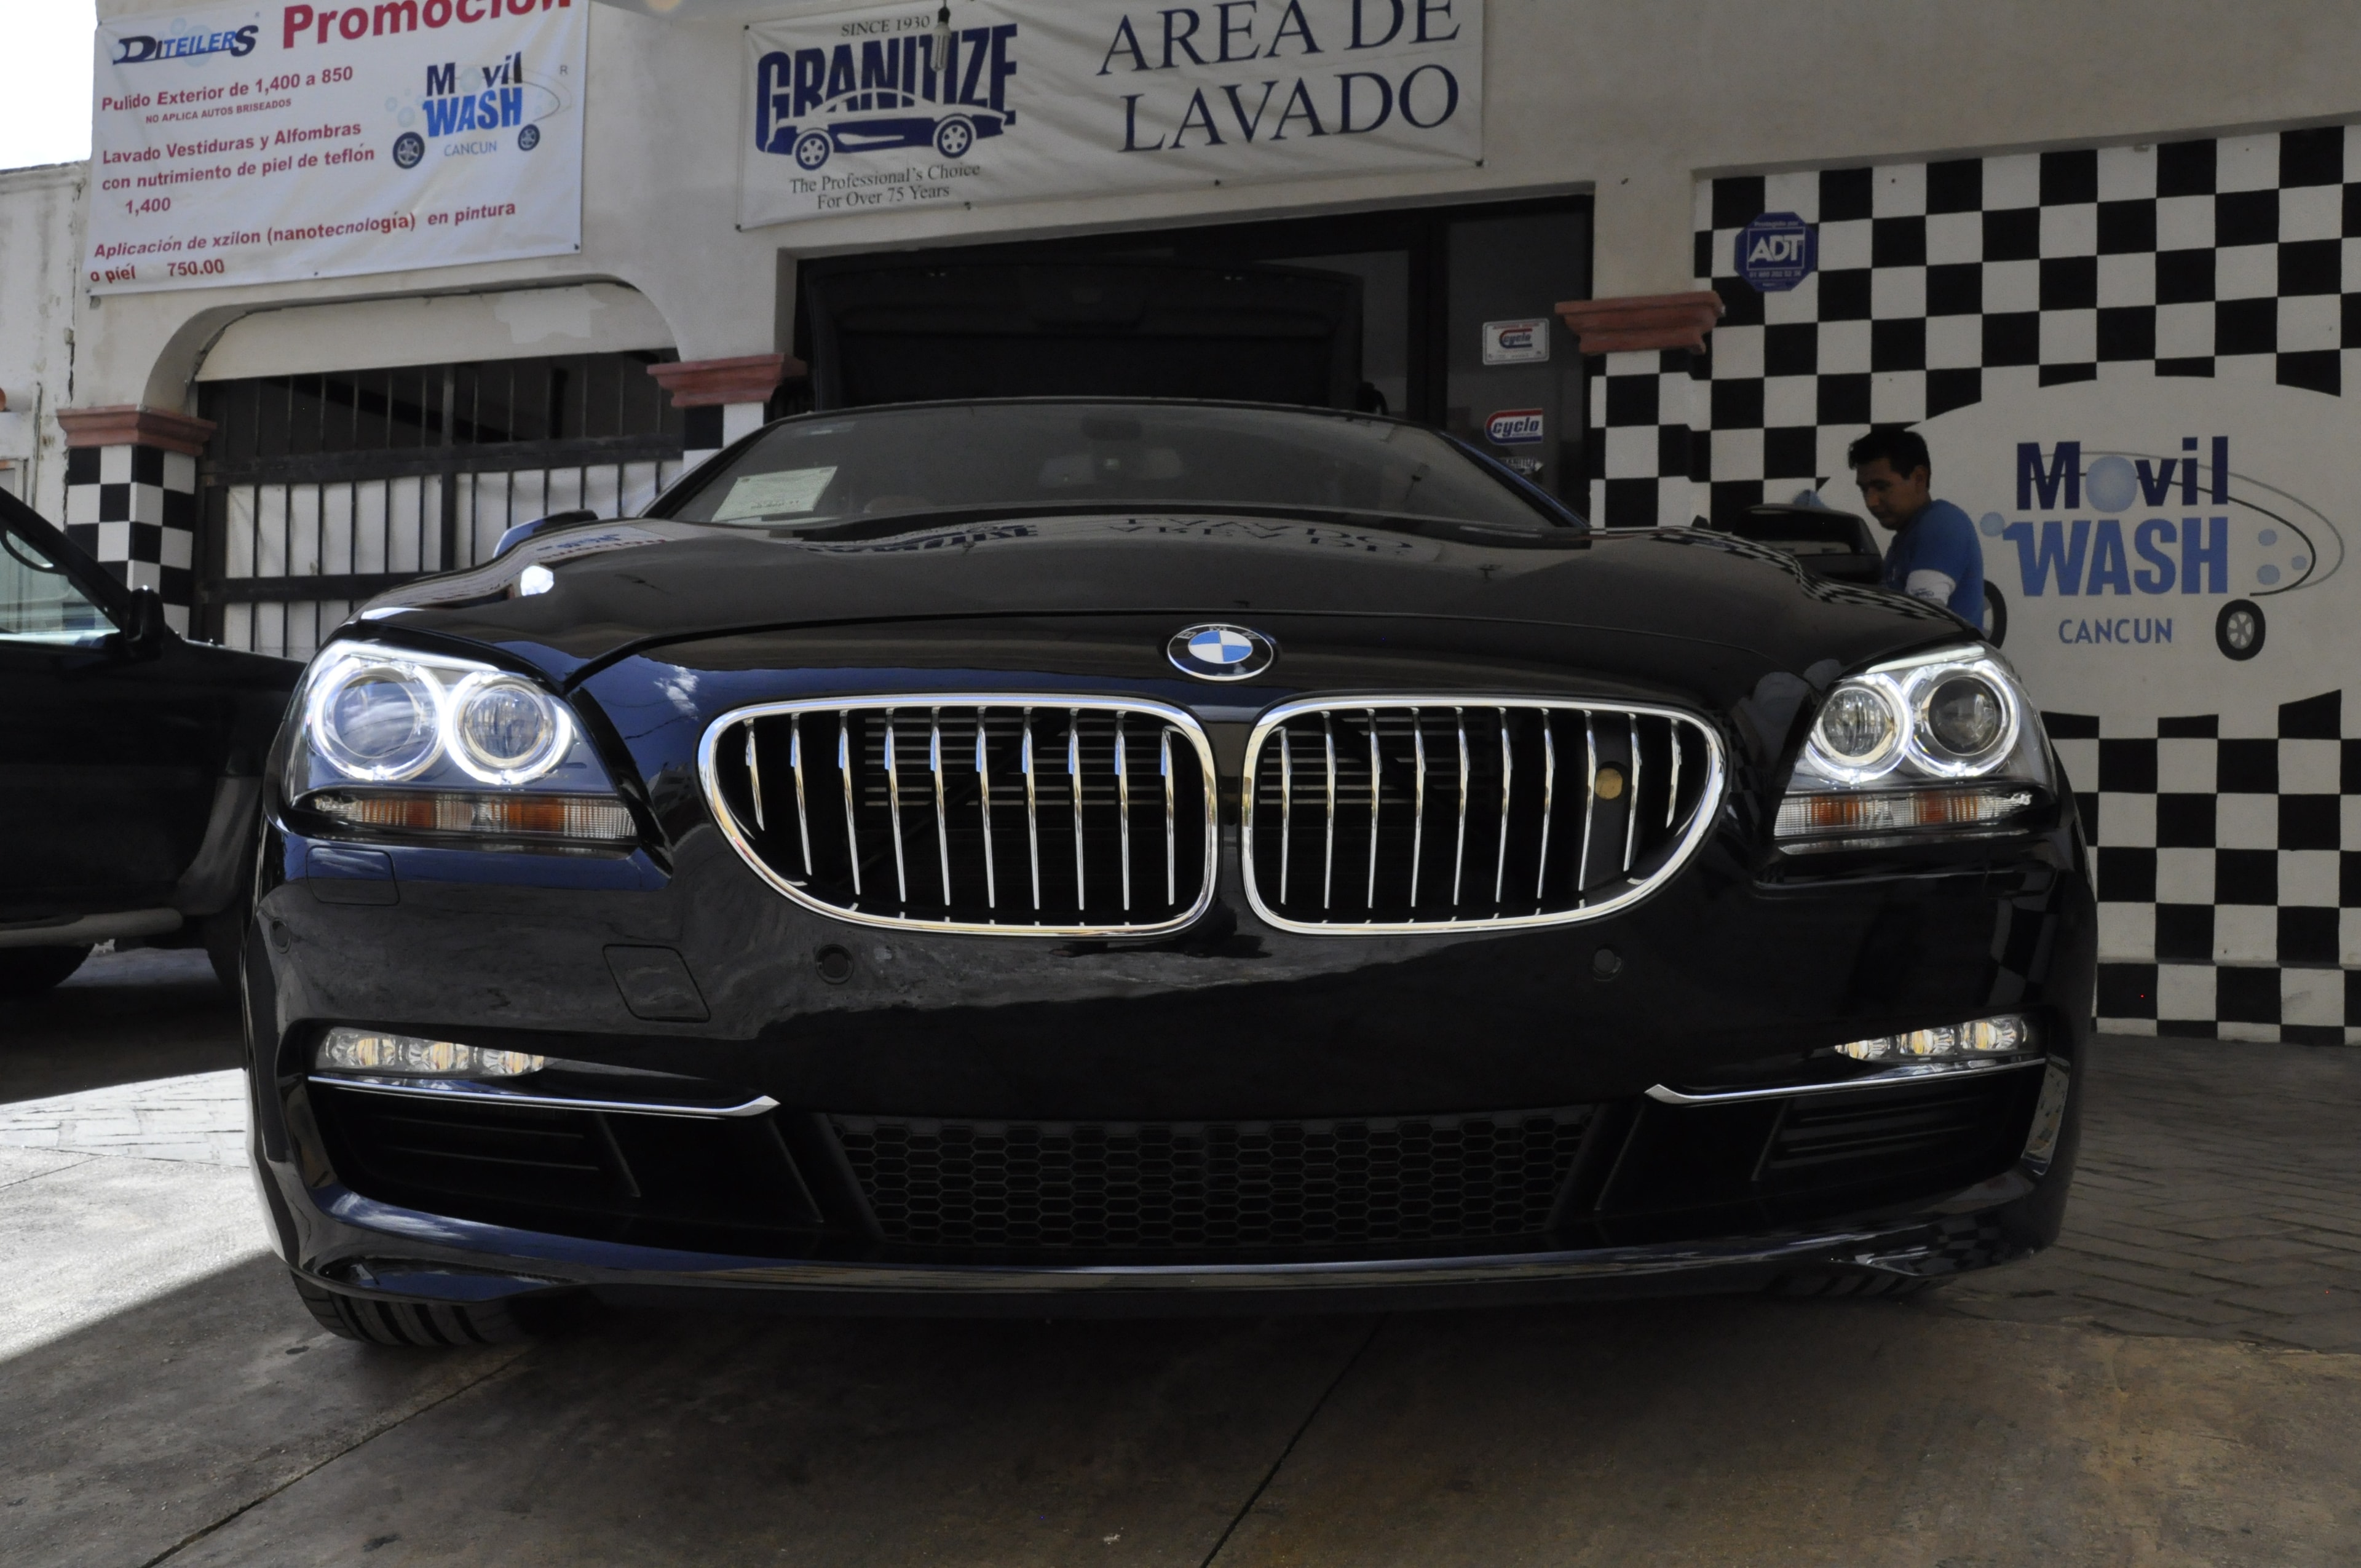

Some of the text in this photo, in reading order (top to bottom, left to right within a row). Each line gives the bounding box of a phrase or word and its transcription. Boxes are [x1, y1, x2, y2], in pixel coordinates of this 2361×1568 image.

[841, 15, 930, 37] SINCE 1930
[1096, 0, 1461, 76] AREA DE
[102, 66, 353, 111] Pulido Exterior de 1,400 a 850
[756, 23, 1018, 153] GRANITIZE
[146, 98, 291, 124] NO APLICA AUTOS BRISEADOS
[422, 87, 523, 138] WASH
[1117, 65, 1459, 153] LAVADO
[103, 124, 361, 164] Lavado Vestiduras y Alfombras
[444, 141, 497, 157] CANCUN
[102, 143, 375, 191] con nutrimiento de piel de teflón
[789, 163, 981, 194] The Professional's Choice
[125, 197, 171, 216] 1,400
[817, 185, 950, 210] For Over 75 Years
[94, 203, 516, 259] Aplicación de xzilon (nanotecnología) en pintura
[1748, 234, 1805, 263] ADT
[90, 272, 100, 282] o
[167, 258, 224, 277] 750.00
[1492, 417, 1540, 437] cyclo
[2003, 517, 2228, 597] WASH
[2058, 618, 2173, 644] CANCUN
